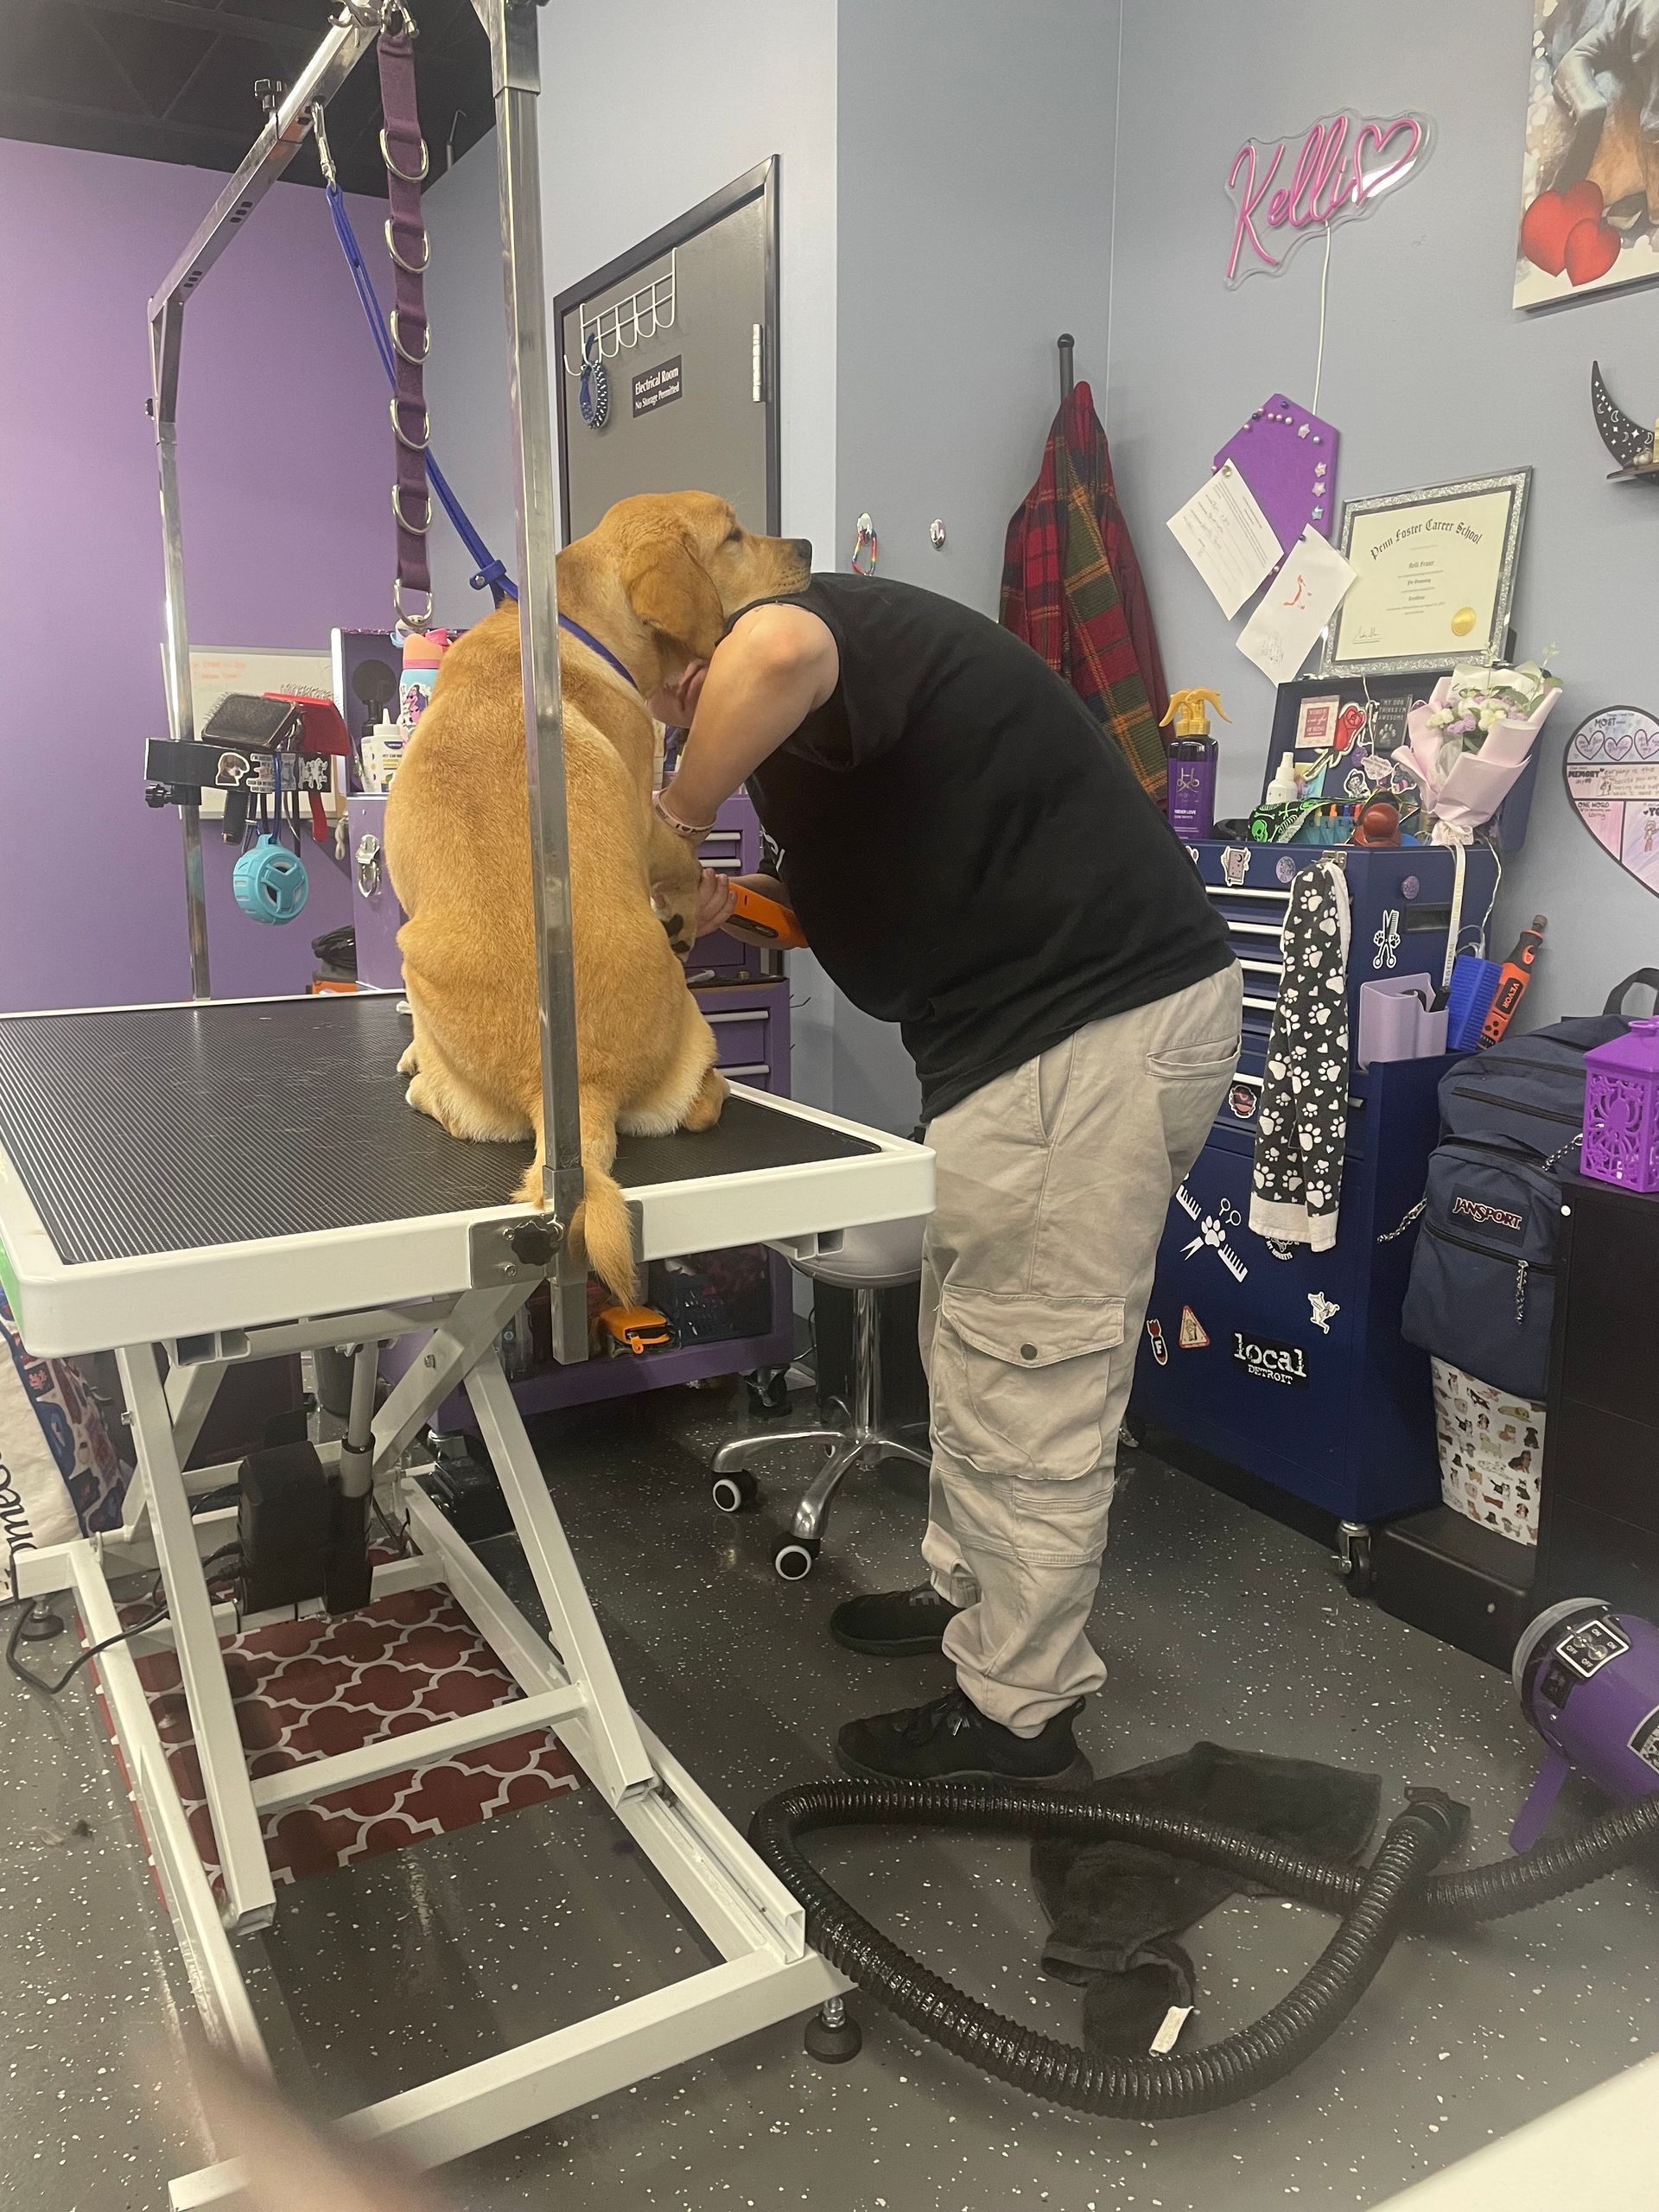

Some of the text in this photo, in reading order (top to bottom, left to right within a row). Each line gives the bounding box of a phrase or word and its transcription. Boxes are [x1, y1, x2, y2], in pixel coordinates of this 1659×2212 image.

[1227, 116, 1357, 278] Kelli
[636, 367, 679, 396] Electrical Room
[636, 381, 680, 410] No Storage Permitted
[1370, 518, 1483, 560] Penn Foster Career School
[1594, 718, 1617, 728] MOST
[1502, 982, 1521, 1009] VEVOR
[1452, 1197, 1522, 1230] JANSPORT
[1234, 1332, 1307, 1378] local
[1247, 1364, 1294, 1385] DETROIT
[1592, 1629, 1603, 1637] ON
[1607, 1642, 1618, 1650] ON
[1566, 1645, 1579, 1655] OFF
[1581, 1658, 1594, 1668] OFF
